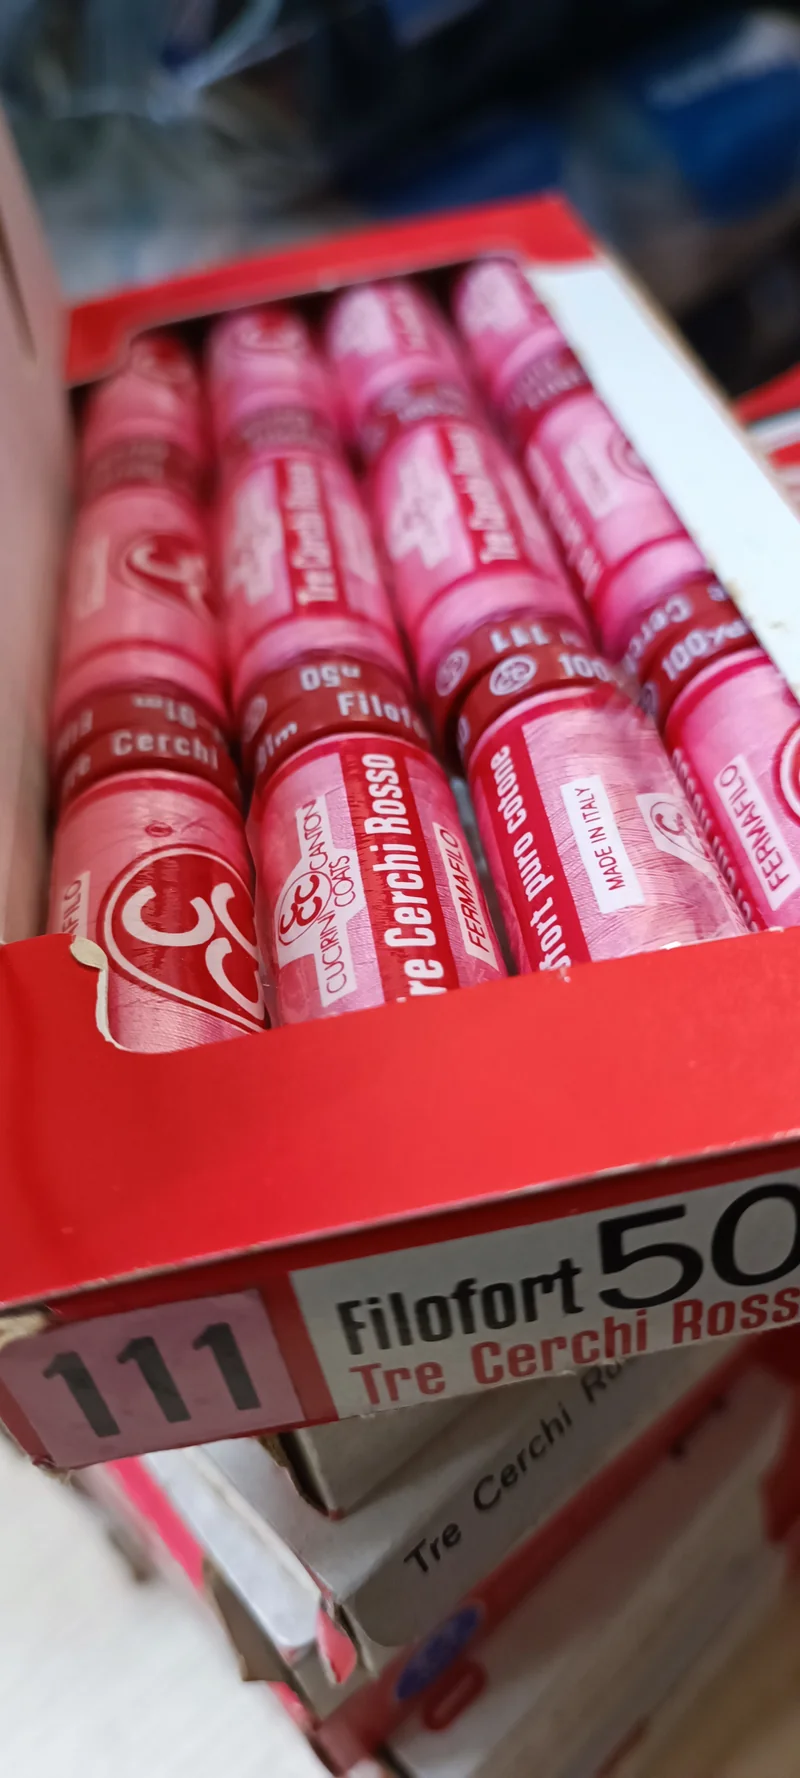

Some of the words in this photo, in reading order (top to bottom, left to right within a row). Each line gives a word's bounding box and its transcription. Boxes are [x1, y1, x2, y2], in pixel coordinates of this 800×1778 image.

[361, 753, 412, 836] Rosso
[490, 745, 528, 834] cotone
[513, 831, 554, 902] puro
[574, 786, 601, 823] ITALY
[588, 825, 607, 844] IN
[719, 763, 790, 892] FERMAFILO
[329, 855, 356, 907] COATS
[370, 843, 437, 948] Cerchi
[440, 828, 490, 953] FERMAFILO
[594, 845, 626, 891] MADE
[396, 958, 447, 1003] re
[337, 1257, 585, 1356] Filofort
[598, 1182, 800, 1311] 50
[43, 1321, 262, 1438] 111
[349, 1361, 446, 1406] Tre
[471, 1308, 648, 1386] Cerchi
[403, 1520, 463, 1575] Tre
[472, 1402, 573, 1512] Cerchi
